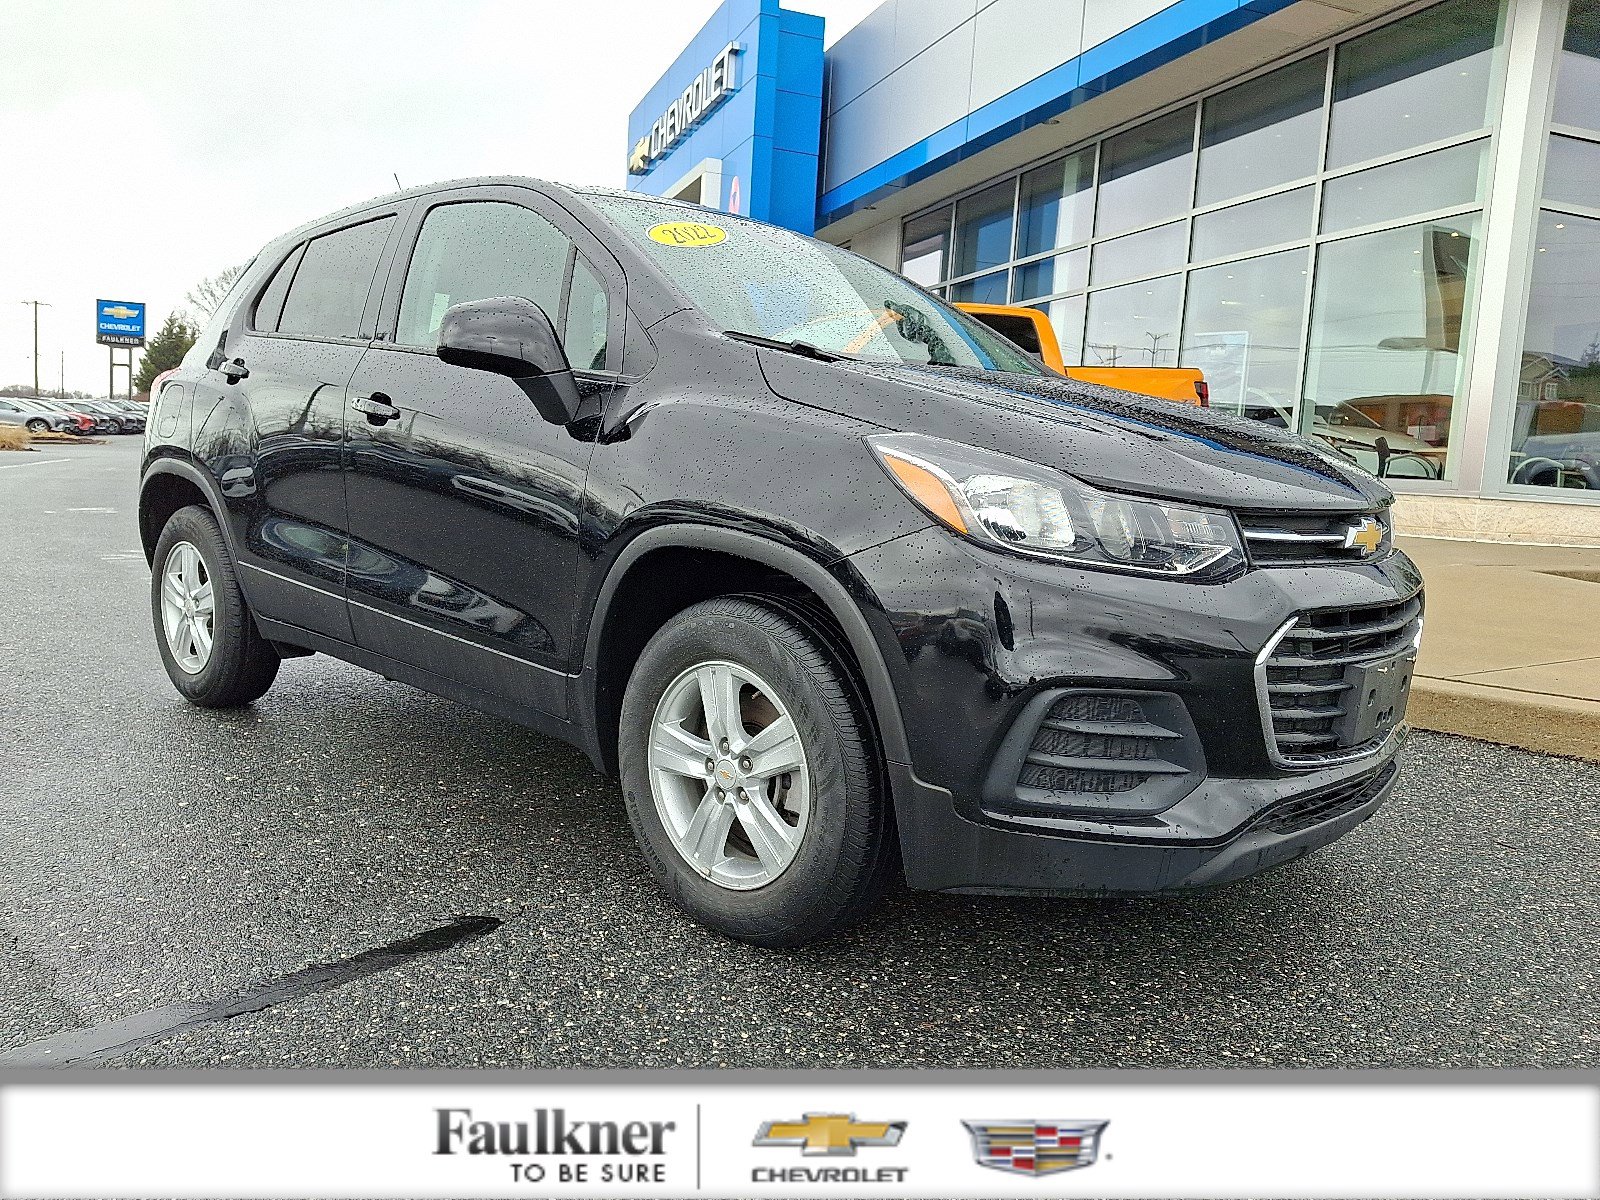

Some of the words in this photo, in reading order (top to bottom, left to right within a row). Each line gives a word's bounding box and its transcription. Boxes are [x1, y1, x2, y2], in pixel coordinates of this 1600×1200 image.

[650, 40, 744, 161] CHEVROLET
[661, 224, 716, 243] 2022
[100, 322, 141, 332] CHEVROLET
[102, 335, 139, 344] FAULKNER
